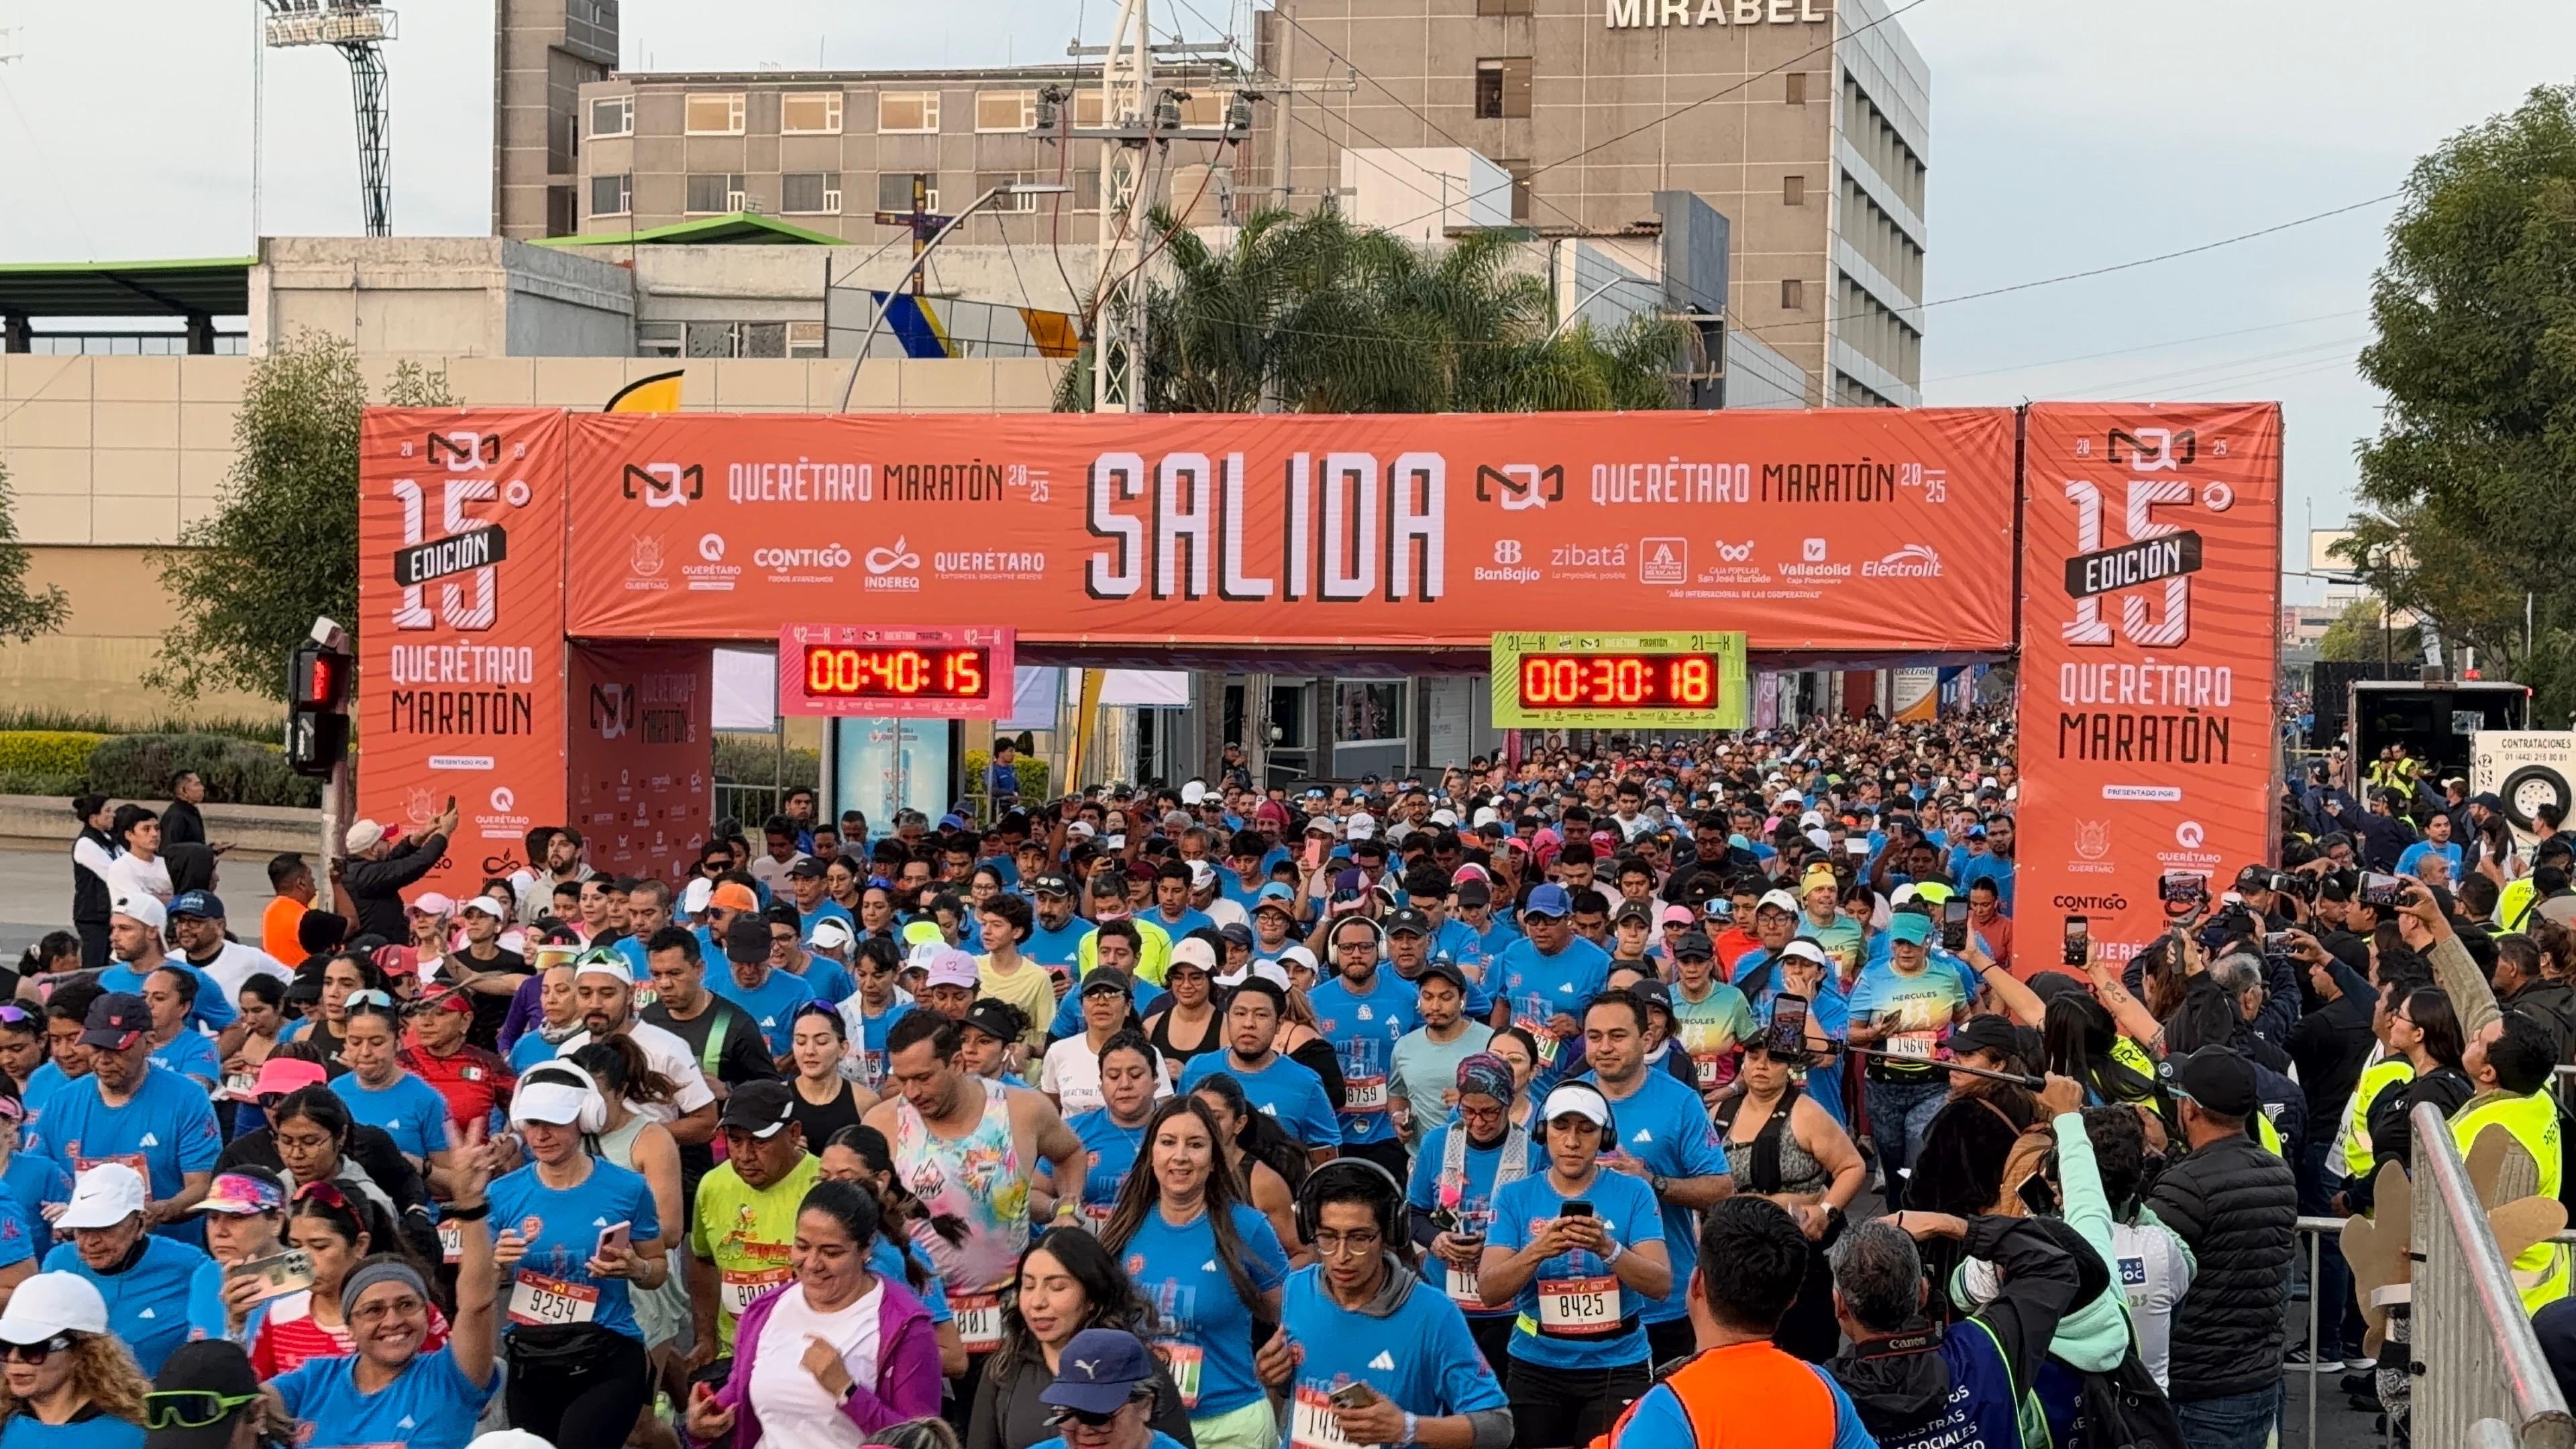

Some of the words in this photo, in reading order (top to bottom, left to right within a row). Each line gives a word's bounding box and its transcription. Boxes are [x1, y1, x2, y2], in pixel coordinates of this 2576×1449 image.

[1605, 0, 1825, 28] MIRABEL
[729, 455, 873, 504] QUERÉTARO
[883, 458, 1003, 501] MARATÓN
[1591, 456, 1750, 506] QUERÉTARO
[1761, 457, 1895, 502] MARATÓN
[1085, 451, 1446, 603] SALIDA
[411, 532, 489, 582] EDICIÓN
[934, 547, 1045, 572] QUERÉTARO
[1550, 542, 1626, 567] zibatá
[2085, 539, 2181, 592] EDICIÓN
[682, 564, 742, 576] QUERÉTARO
[1474, 566, 1541, 584] BanBajío
[1778, 563, 1852, 576] Valladolid
[1861, 559, 1943, 578] Electrolit
[865, 576, 920, 589] INDEREQ
[391, 639, 533, 685] QUERÉTARO
[809, 649, 982, 694] 00:40:15
[1525, 658, 1709, 703] 00:30:18
[2059, 657, 2232, 708] QUERÉTARO
[392, 684, 531, 735] MARATÓN
[2058, 707, 2230, 765] MARATÓN
[2502, 738, 2571, 749] CONTRATACIONES
[2107, 788, 2157, 797] PRESENTADO
[475, 813, 529, 825] QUERÉTARO
[2156, 851, 2222, 863] QUERÉTARO
[2053, 893, 2127, 912] CONTIGO
[1892, 991, 1938, 1002] HERCULES
[530, 1289, 577, 1323] 9254
[1560, 1293, 1604, 1318] 8425
[1888, 1336, 1927, 1350] Canon
